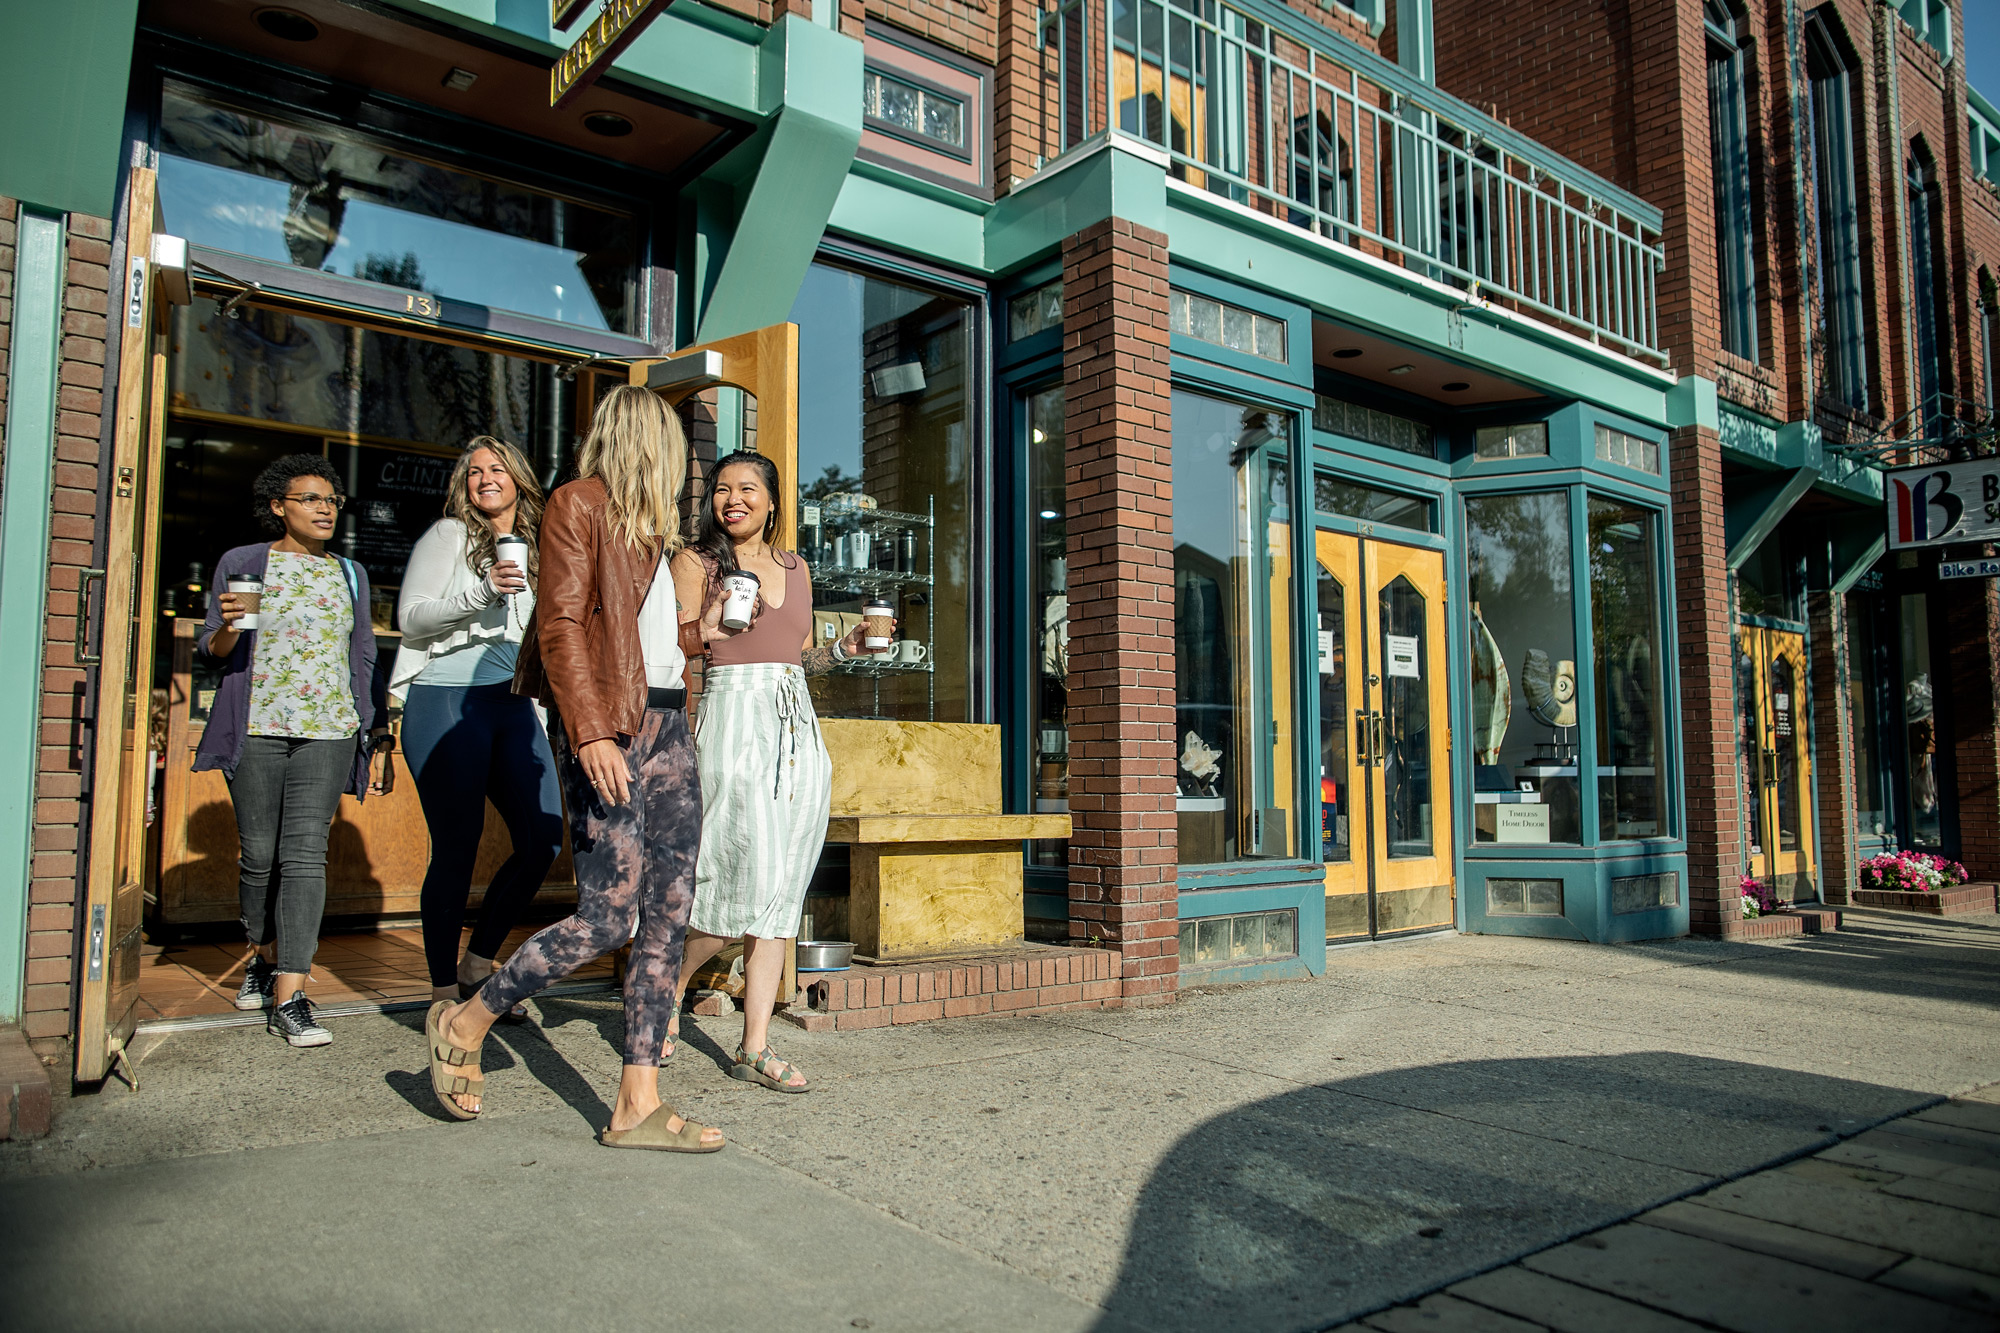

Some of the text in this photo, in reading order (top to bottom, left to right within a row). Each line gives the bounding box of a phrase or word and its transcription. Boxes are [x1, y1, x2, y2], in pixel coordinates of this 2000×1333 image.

[557, 31, 593, 93] ICE
[406, 294, 442, 318] 131
[1356, 521, 1374, 535] 129
[1942, 561, 2000, 577] Bike Re
